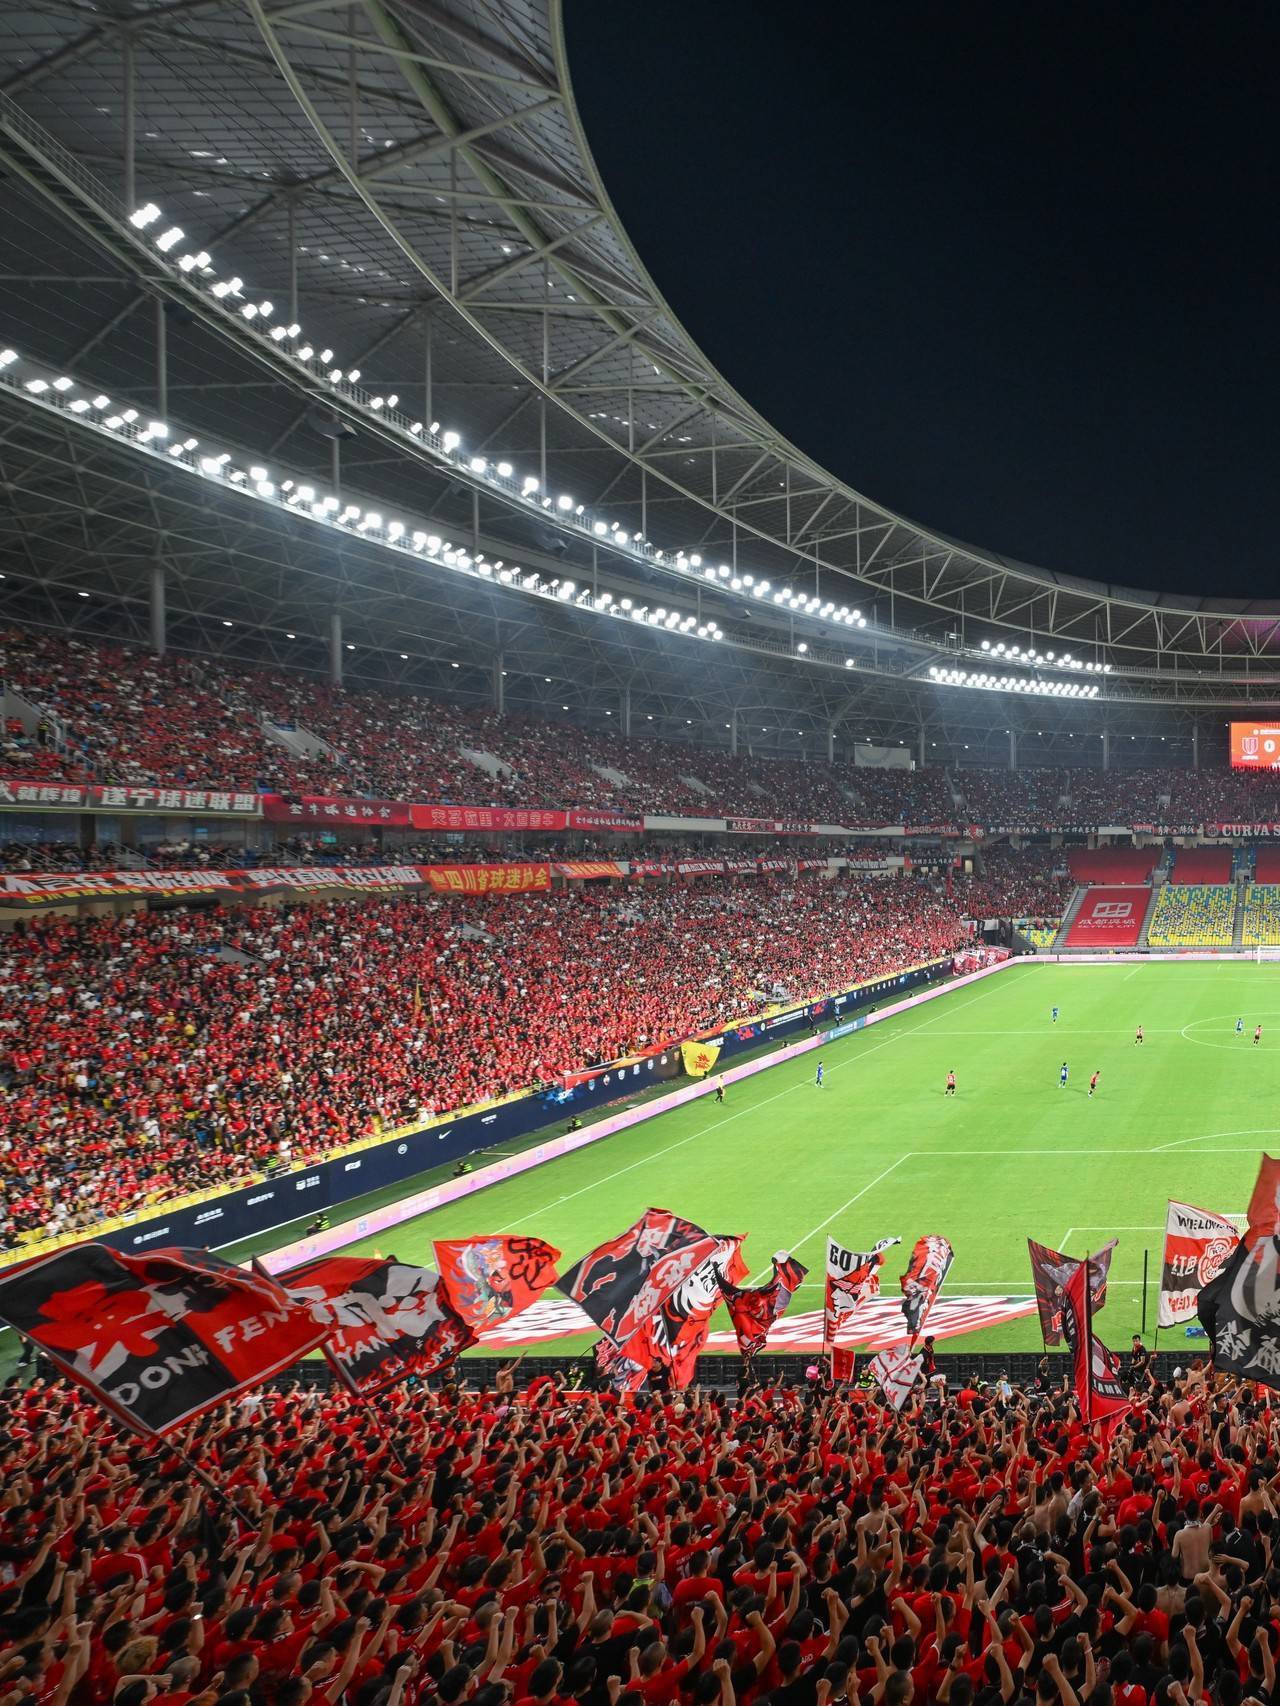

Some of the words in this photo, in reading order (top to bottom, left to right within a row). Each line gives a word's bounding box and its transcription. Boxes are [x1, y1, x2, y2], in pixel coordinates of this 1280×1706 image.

[101, 787, 254, 811] 遂宁球迷联盟
[289, 803, 390, 818] 金牛球迷协会
[1222, 825, 1269, 837] CURVA
[444, 868, 548, 891] 四川省球迷协会
